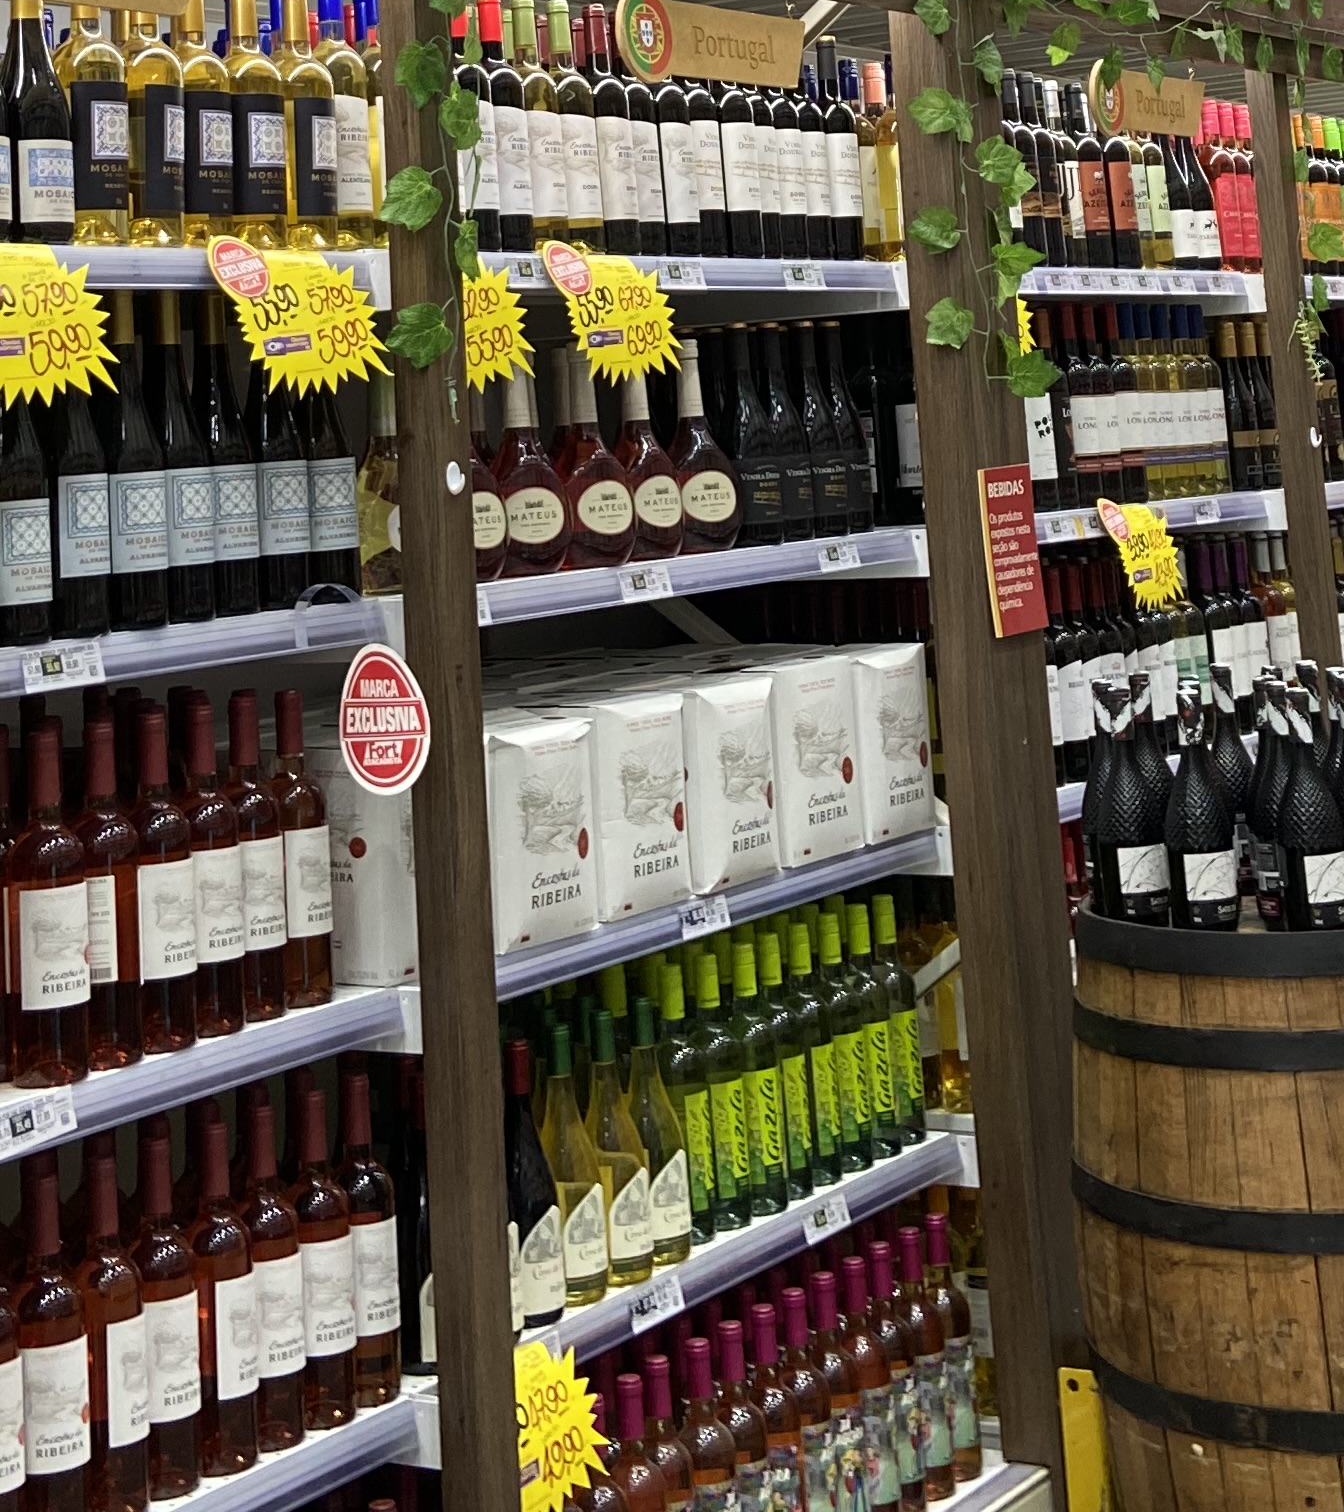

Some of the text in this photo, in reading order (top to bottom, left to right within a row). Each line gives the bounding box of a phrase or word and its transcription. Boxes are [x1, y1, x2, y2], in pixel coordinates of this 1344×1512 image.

[691, 25, 776, 70] Portugal
[1137, 89, 1185, 123] Portugal
[220, 250, 246, 261] MARCA
[218, 260, 264, 276] EXCLUSIVA
[691, 491, 732, 502] MATEUS
[988, 479, 1025, 498] BEBIDAS
[588, 502, 629, 515] MATEUS
[643, 496, 679, 507] MATEUS
[511, 509, 558, 524] MATEUS
[989, 510, 1023, 525] Os produtos
[360, 679, 399, 698] MARCA
[346, 706, 422, 733] EXCLUSIVA
[370, 742, 399, 759] Fort
[889, 788, 926, 808] RIBEIRA
[808, 806, 848, 826] RIBEIRA
[732, 832, 772, 854] RIBEIRA
[633, 855, 680, 879] RIBEIRA
[530, 884, 583, 909] RIBEIRA
[42, 978, 87, 995] RIBEIRA
[873, 1029, 895, 1110] Gazela
[765, 1076, 782, 1163] Gazela
[35, 1441, 85, 1459] RIBEIRA
